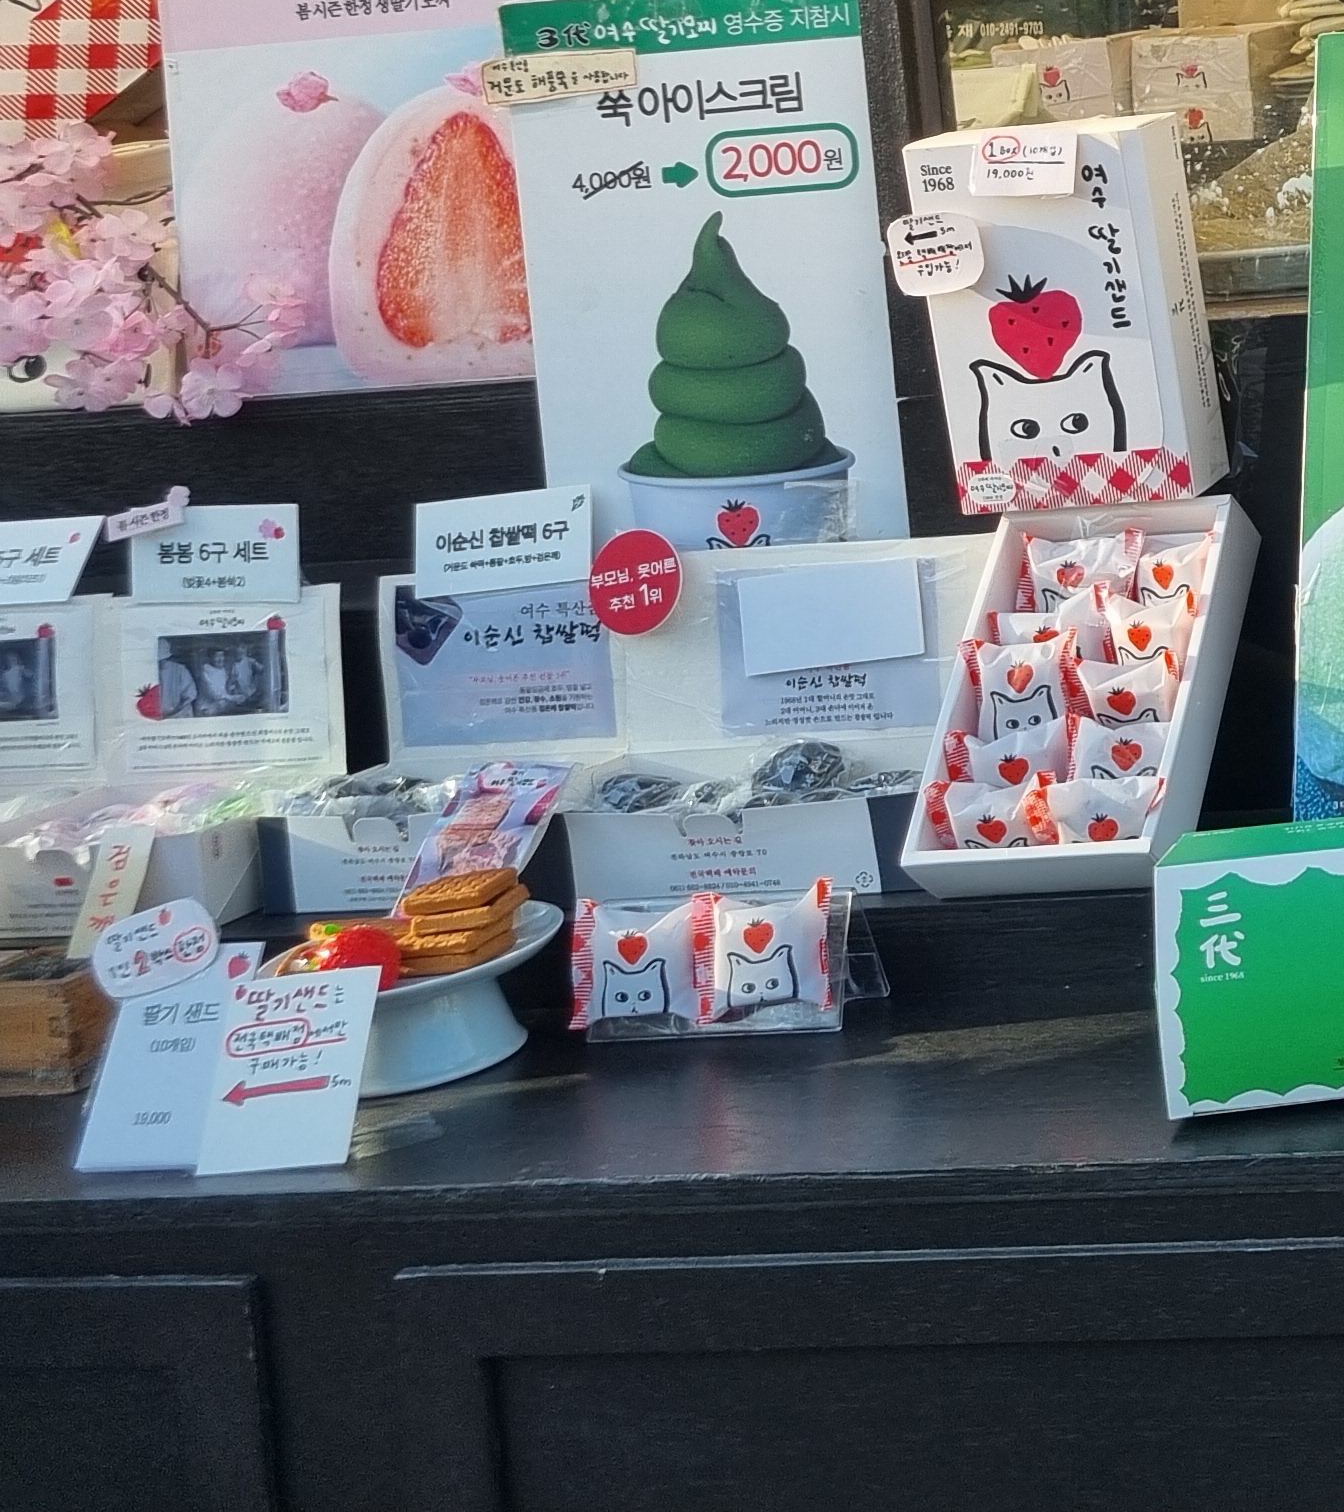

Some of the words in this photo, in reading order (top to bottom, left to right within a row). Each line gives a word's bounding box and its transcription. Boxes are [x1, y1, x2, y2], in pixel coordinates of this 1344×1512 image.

[535, 21, 589, 48] 3代
[723, 10, 784, 35] 영수증
[791, 3, 850, 30] 지참시
[638, 71, 804, 123] 아이스크림
[572, 164, 652, 196] 4,000원
[721, 139, 844, 182] 2,000원
[920, 164, 952, 177] Since
[922, 177, 955, 192] 1968
[1081, 164, 1108, 208] 여수
[436, 529, 484, 554] 이순신
[489, 523, 537, 549] 찹쌀떡
[542, 520, 570, 541] 6구
[199, 541, 228, 563] 6구
[232, 540, 269, 563] 세트
[591, 568, 633, 588] 부모님,
[637, 557, 677, 580] 웃어른
[521, 603, 550, 619] 여수
[609, 594, 635, 612] 추천
[639, 584, 663, 606] 1위
[463, 624, 525, 649] 이순신
[533, 620, 601, 646] 찹쌀떡
[786, 675, 823, 691] 이순신
[828, 673, 867, 688] 찹쌀떡
[1200, 891, 1245, 969] 三代
[1200, 972, 1223, 983] since
[1225, 970, 1245, 981] 1968
[143, 1002, 179, 1026] 딸기
[183, 1002, 220, 1024] 샌드
[331, 1076, 352, 1088] 5m
